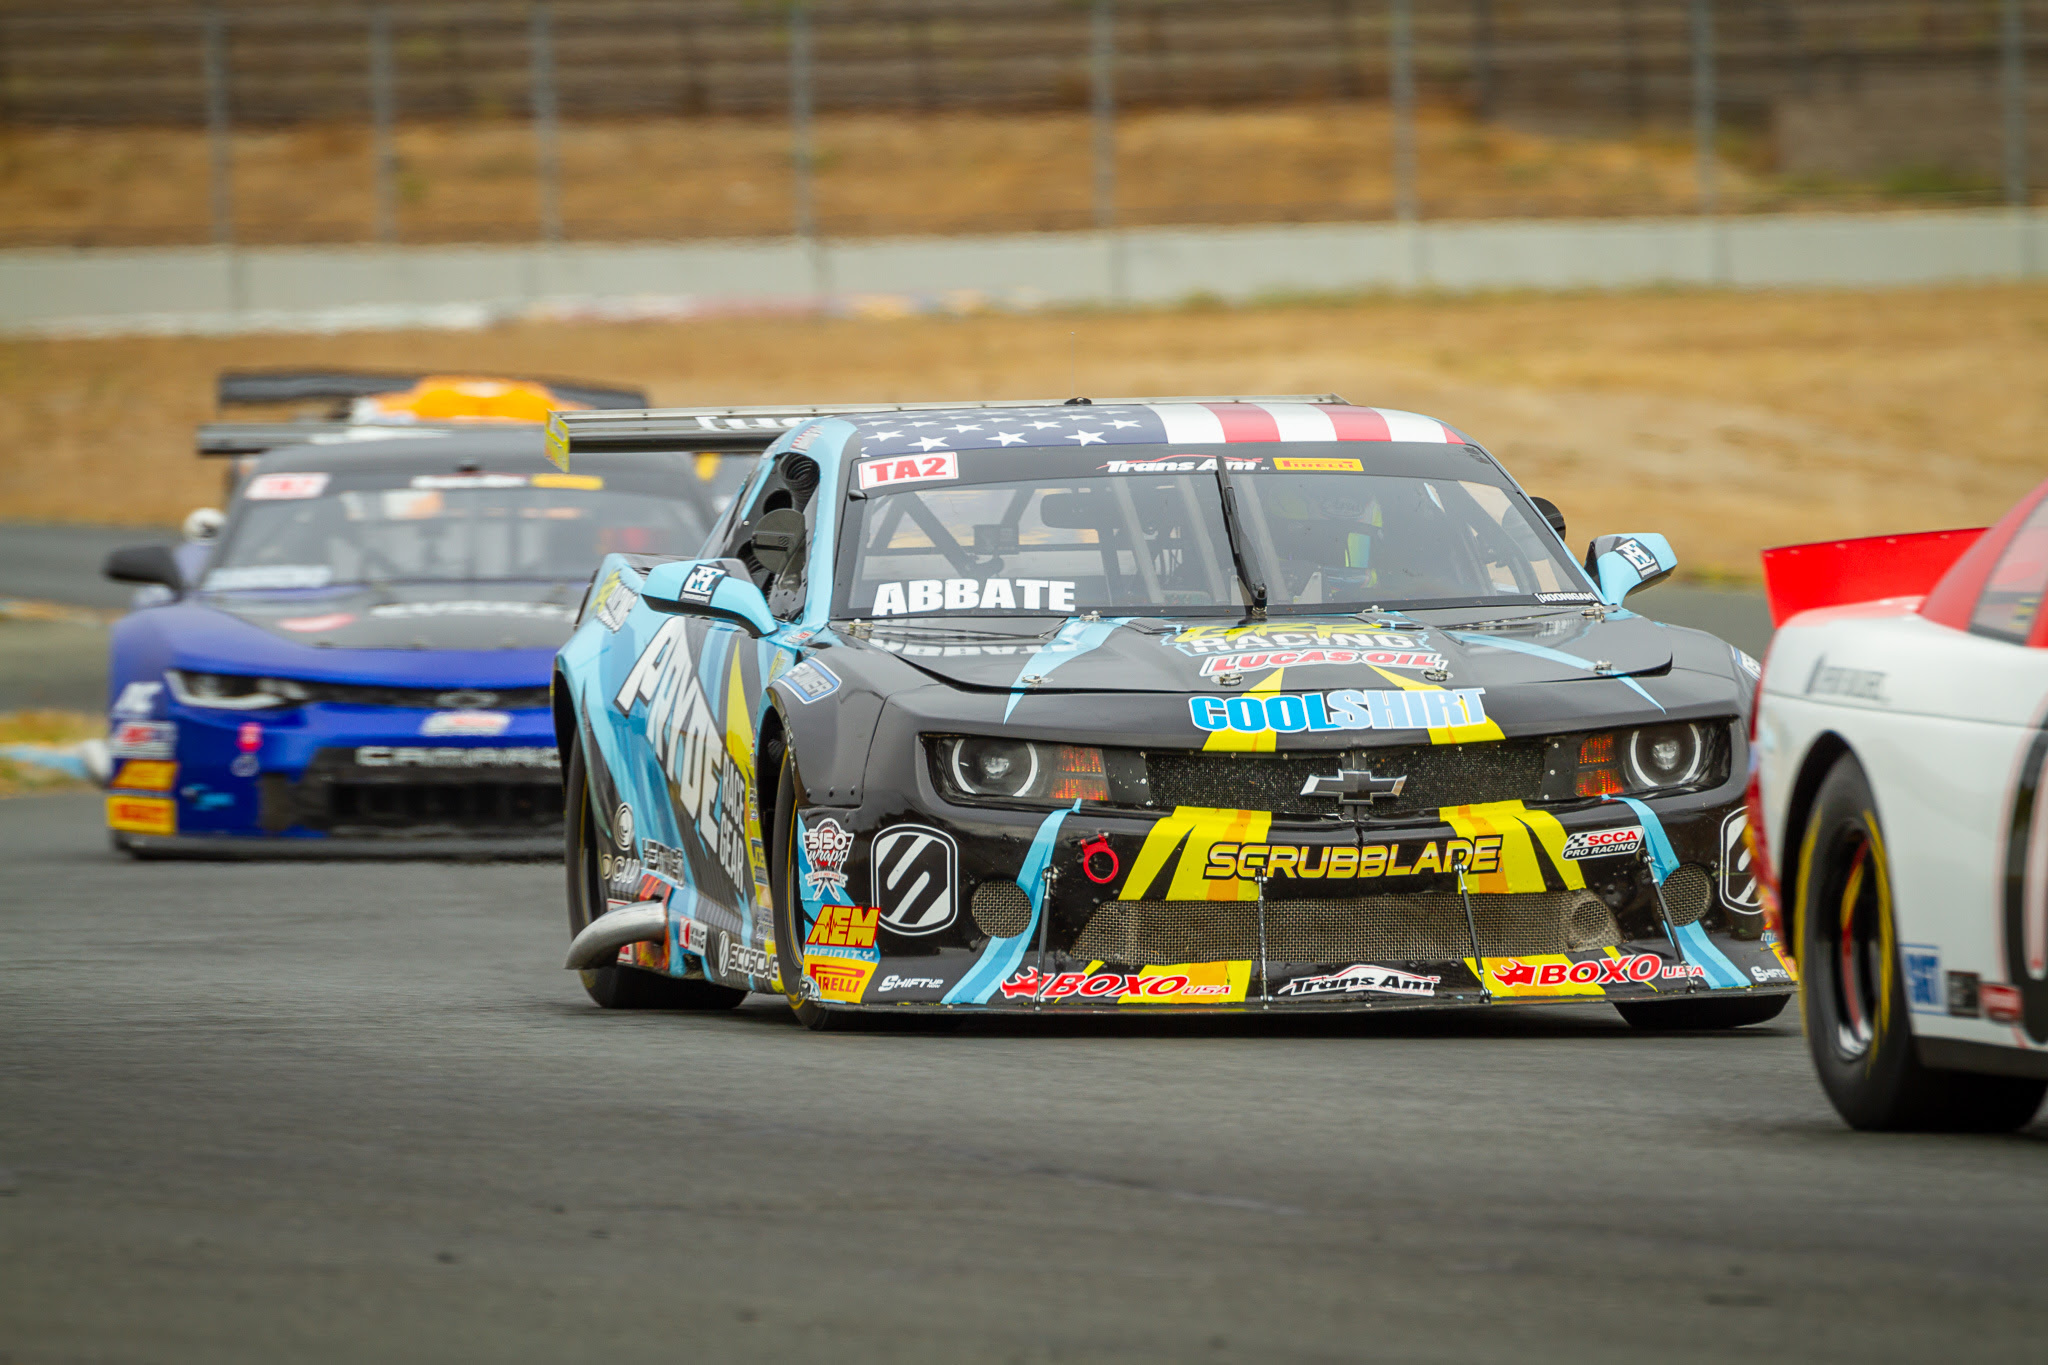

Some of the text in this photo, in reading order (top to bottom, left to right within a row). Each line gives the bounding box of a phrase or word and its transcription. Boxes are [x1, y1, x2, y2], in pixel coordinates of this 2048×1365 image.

[869, 456, 947, 483] TA2
[1106, 459, 1195, 473] Trans
[1196, 457, 1257, 471] Am
[1282, 459, 1355, 469] PIRELLI
[872, 578, 1076, 617] ABBATE
[1191, 633, 1416, 653] RACING
[1212, 650, 1438, 672] LUCAS OIL
[1189, 687, 1487, 733] COOLSHIRT
[721, 756, 746, 835] RACE
[808, 832, 847, 850] 5150
[1564, 842, 1637, 858] PRO RACING
[1587, 830, 1638, 846] SCCA
[719, 811, 745, 895] GEAR
[808, 849, 846, 867] wraps
[1203, 834, 1502, 880] SCRUBBLADE
[810, 963, 866, 994] PIRELLI
[1537, 954, 1706, 986] BOXO USA
[1042, 972, 1231, 998] BOXO USA
[1293, 975, 1434, 994] Trans Am
